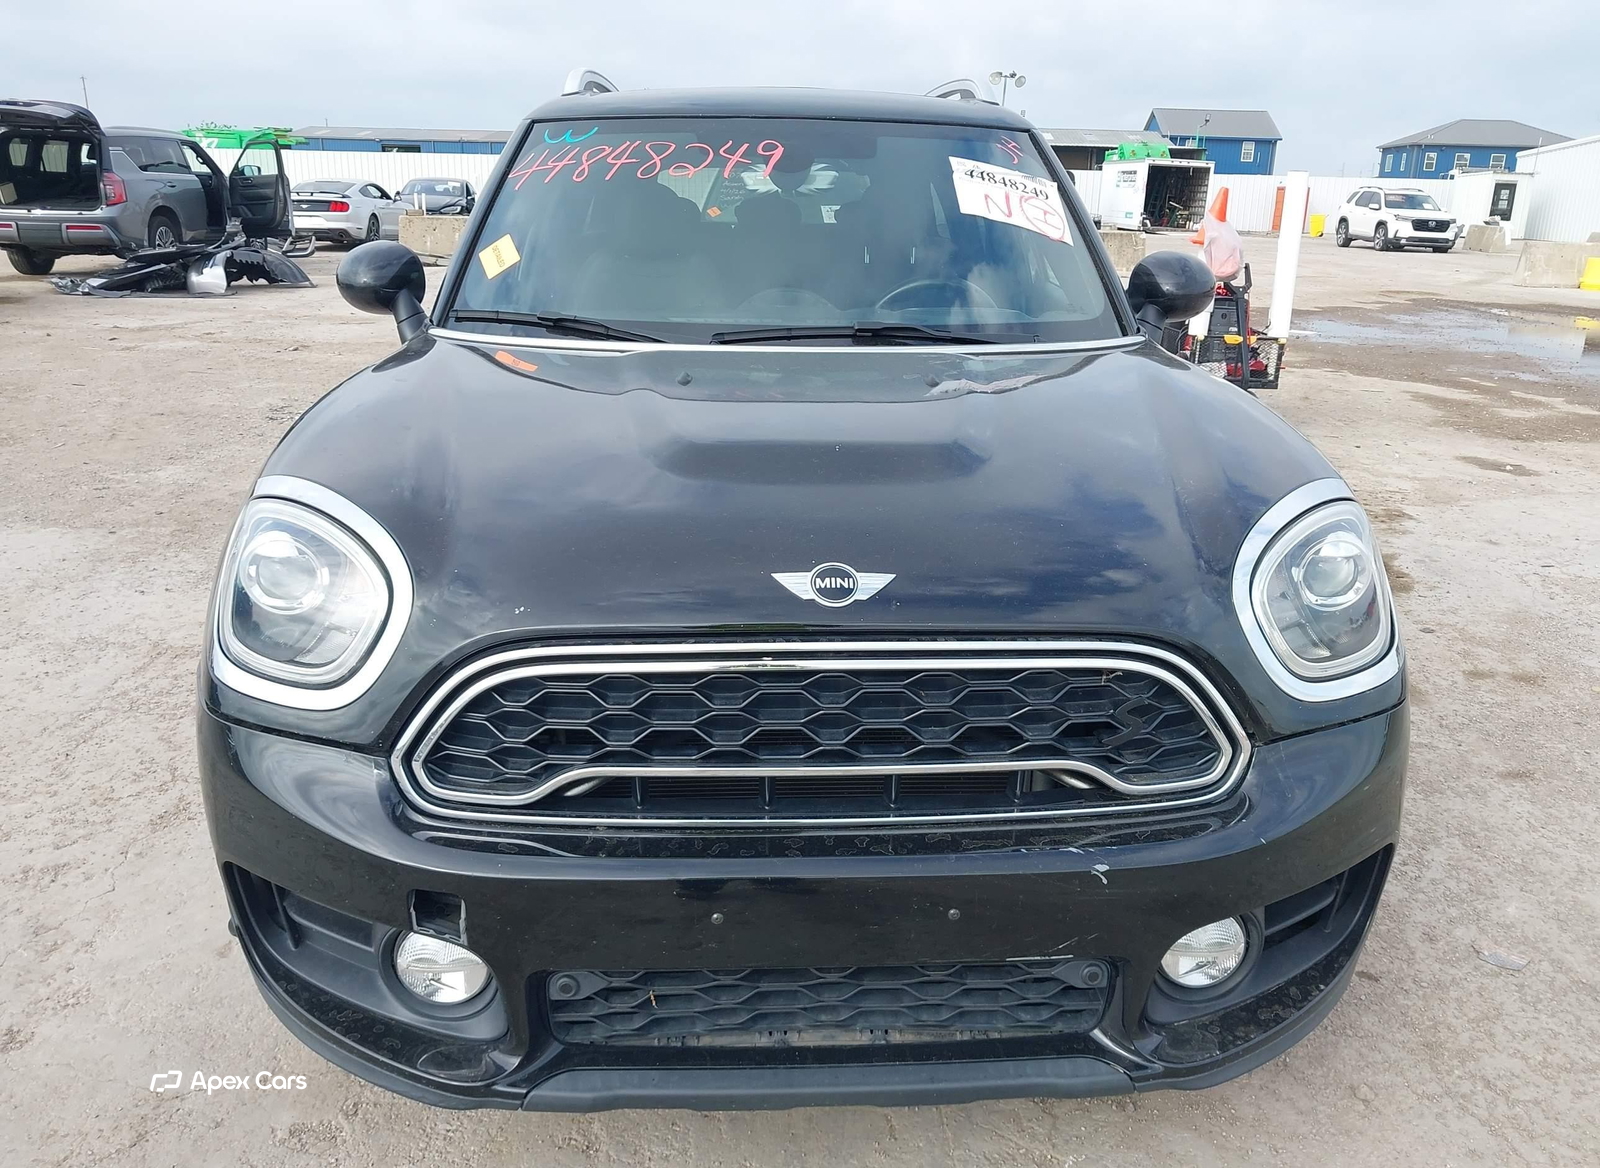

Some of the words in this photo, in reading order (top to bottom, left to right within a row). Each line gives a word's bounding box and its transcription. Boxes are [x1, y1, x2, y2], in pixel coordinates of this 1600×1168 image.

[507, 139, 785, 191] 44848249
[964, 168, 1049, 201] 44848249
[815, 577, 855, 589] MINI
